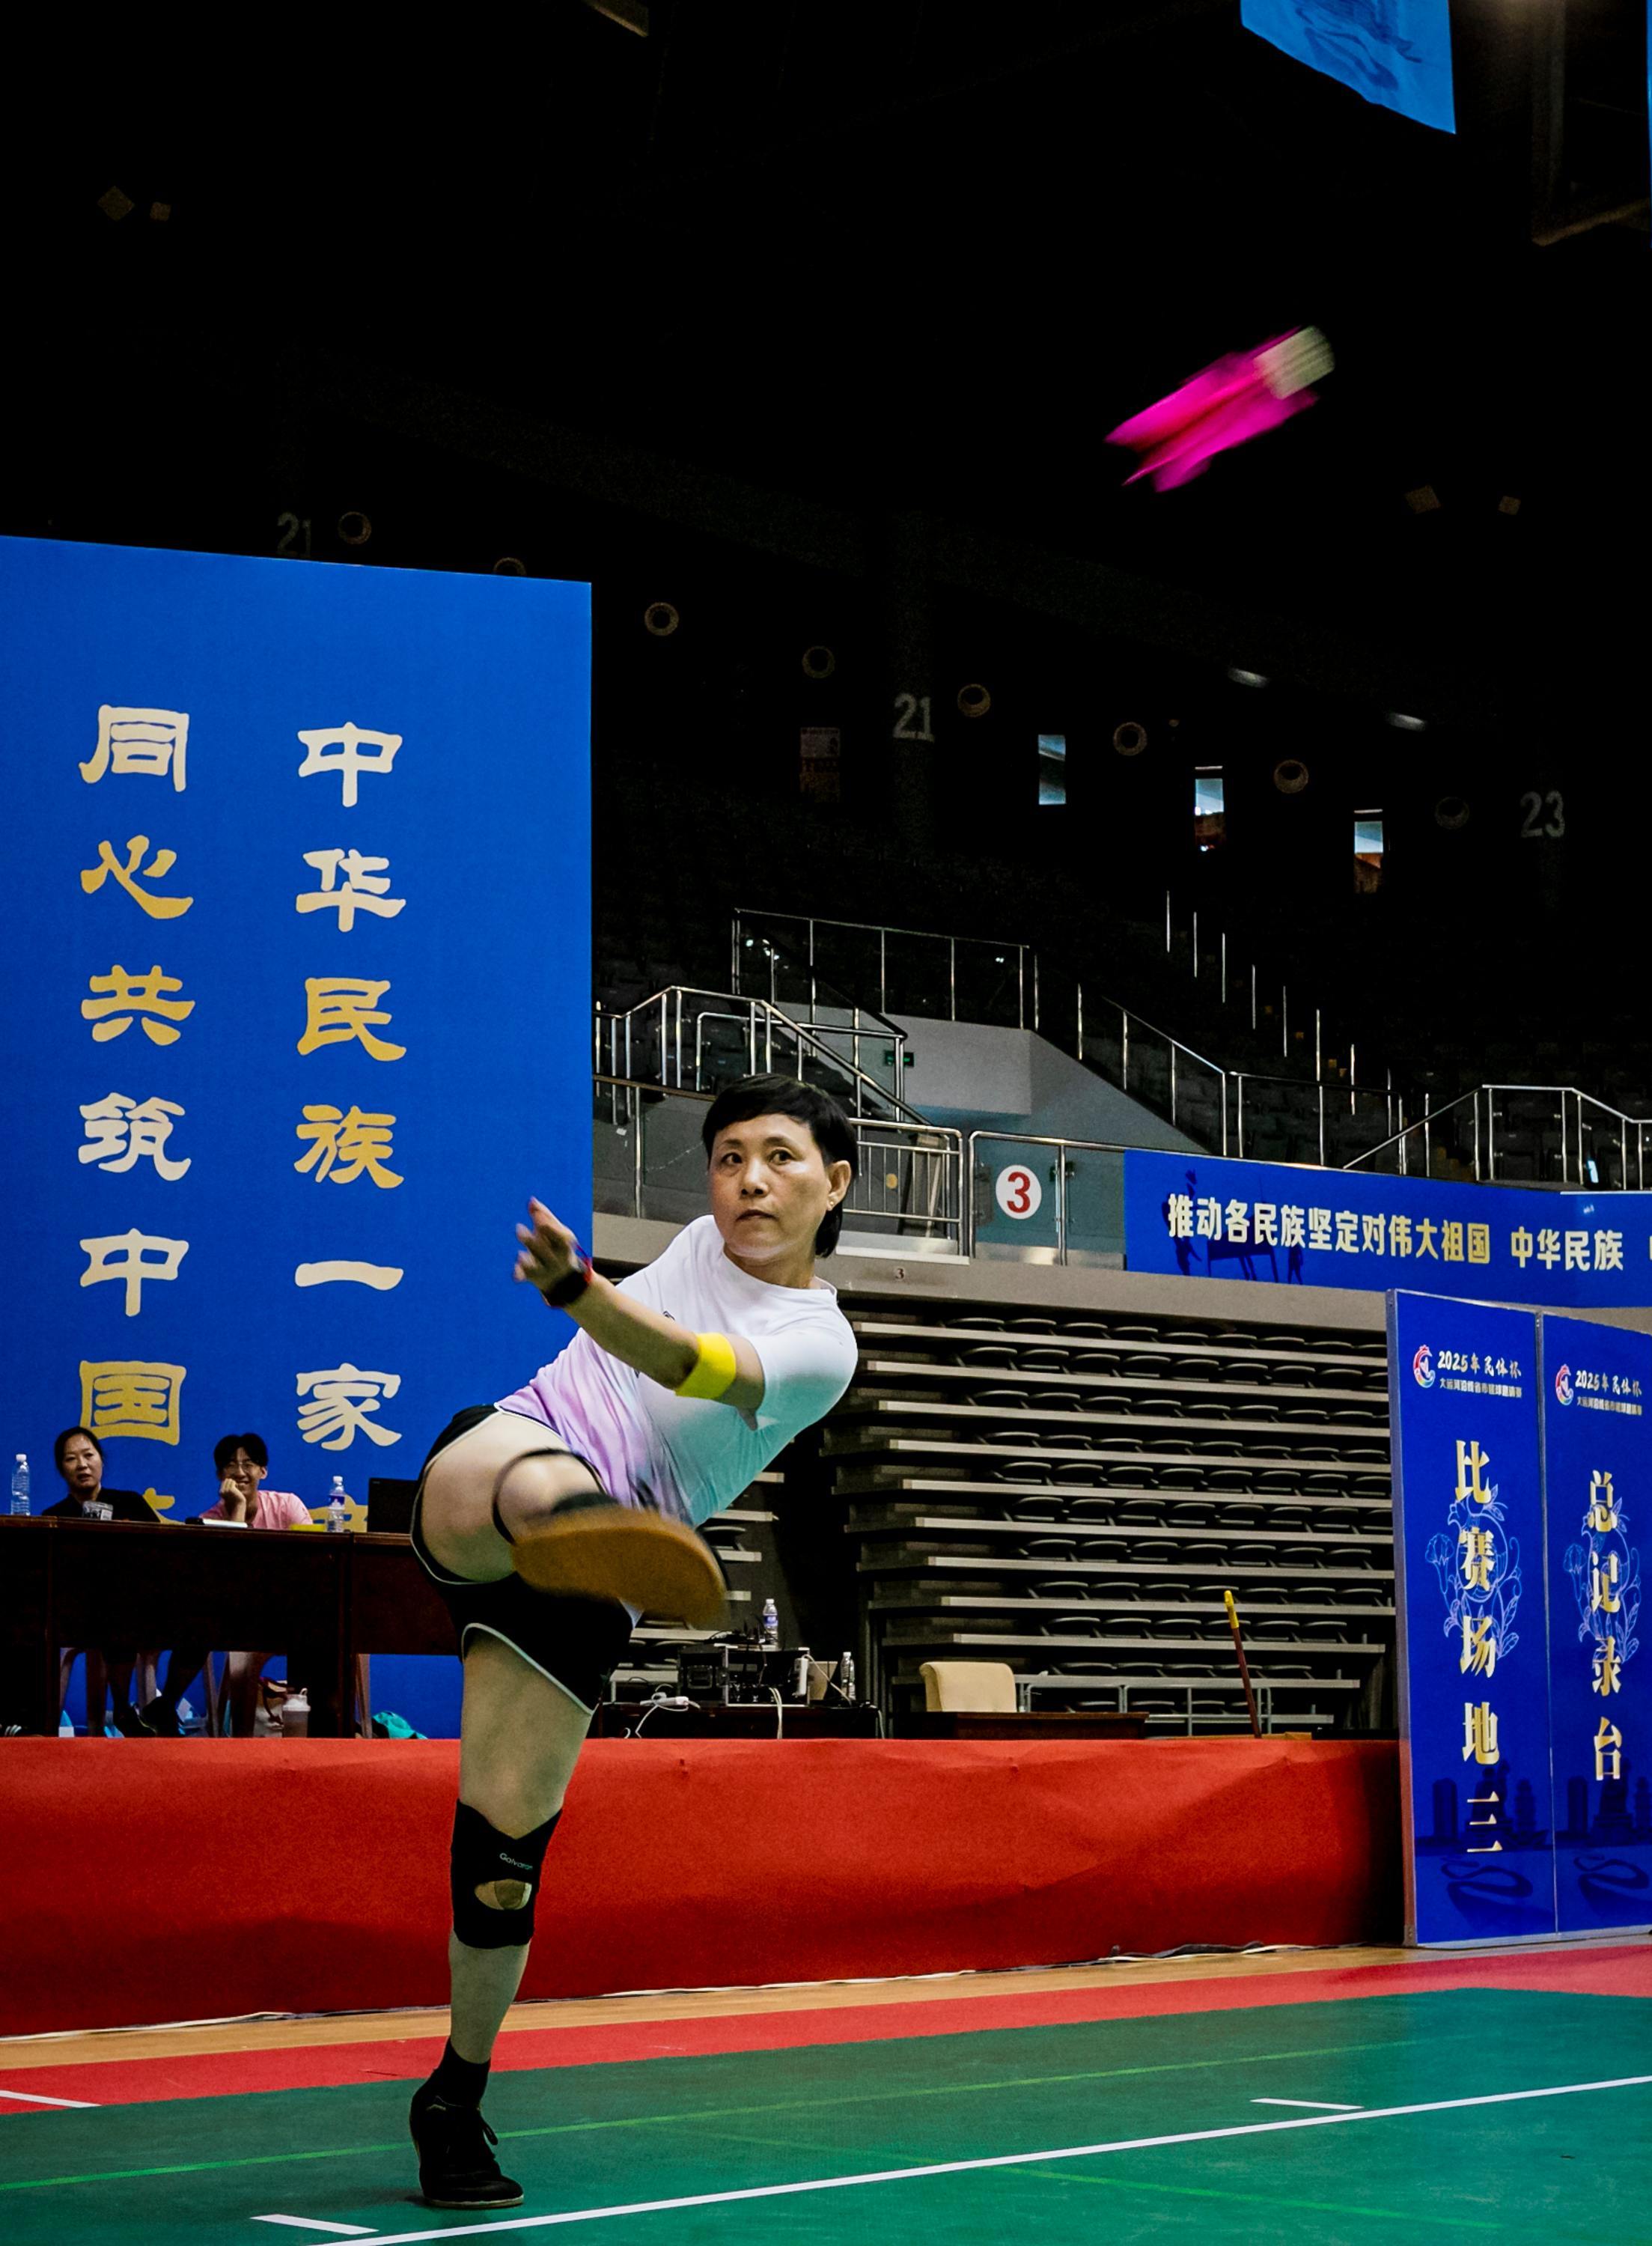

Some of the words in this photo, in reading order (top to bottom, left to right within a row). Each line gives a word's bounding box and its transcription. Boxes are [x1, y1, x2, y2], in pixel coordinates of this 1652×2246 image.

[277, 512, 311, 559] 21
[892, 693, 935, 742] 21
[1520, 790, 1565, 838] 23
[78, 704, 195, 1524] 同心共筑中国
[1007, 1172, 1031, 1213] 3
[1168, 1193, 1490, 1264] 推动各民族坚定对伟大祖国
[1510, 1226, 1624, 1271] 中华民族
[1455, 1439, 1503, 1853] 比赛场地三
[1588, 1469, 1623, 1782] 总记录台
